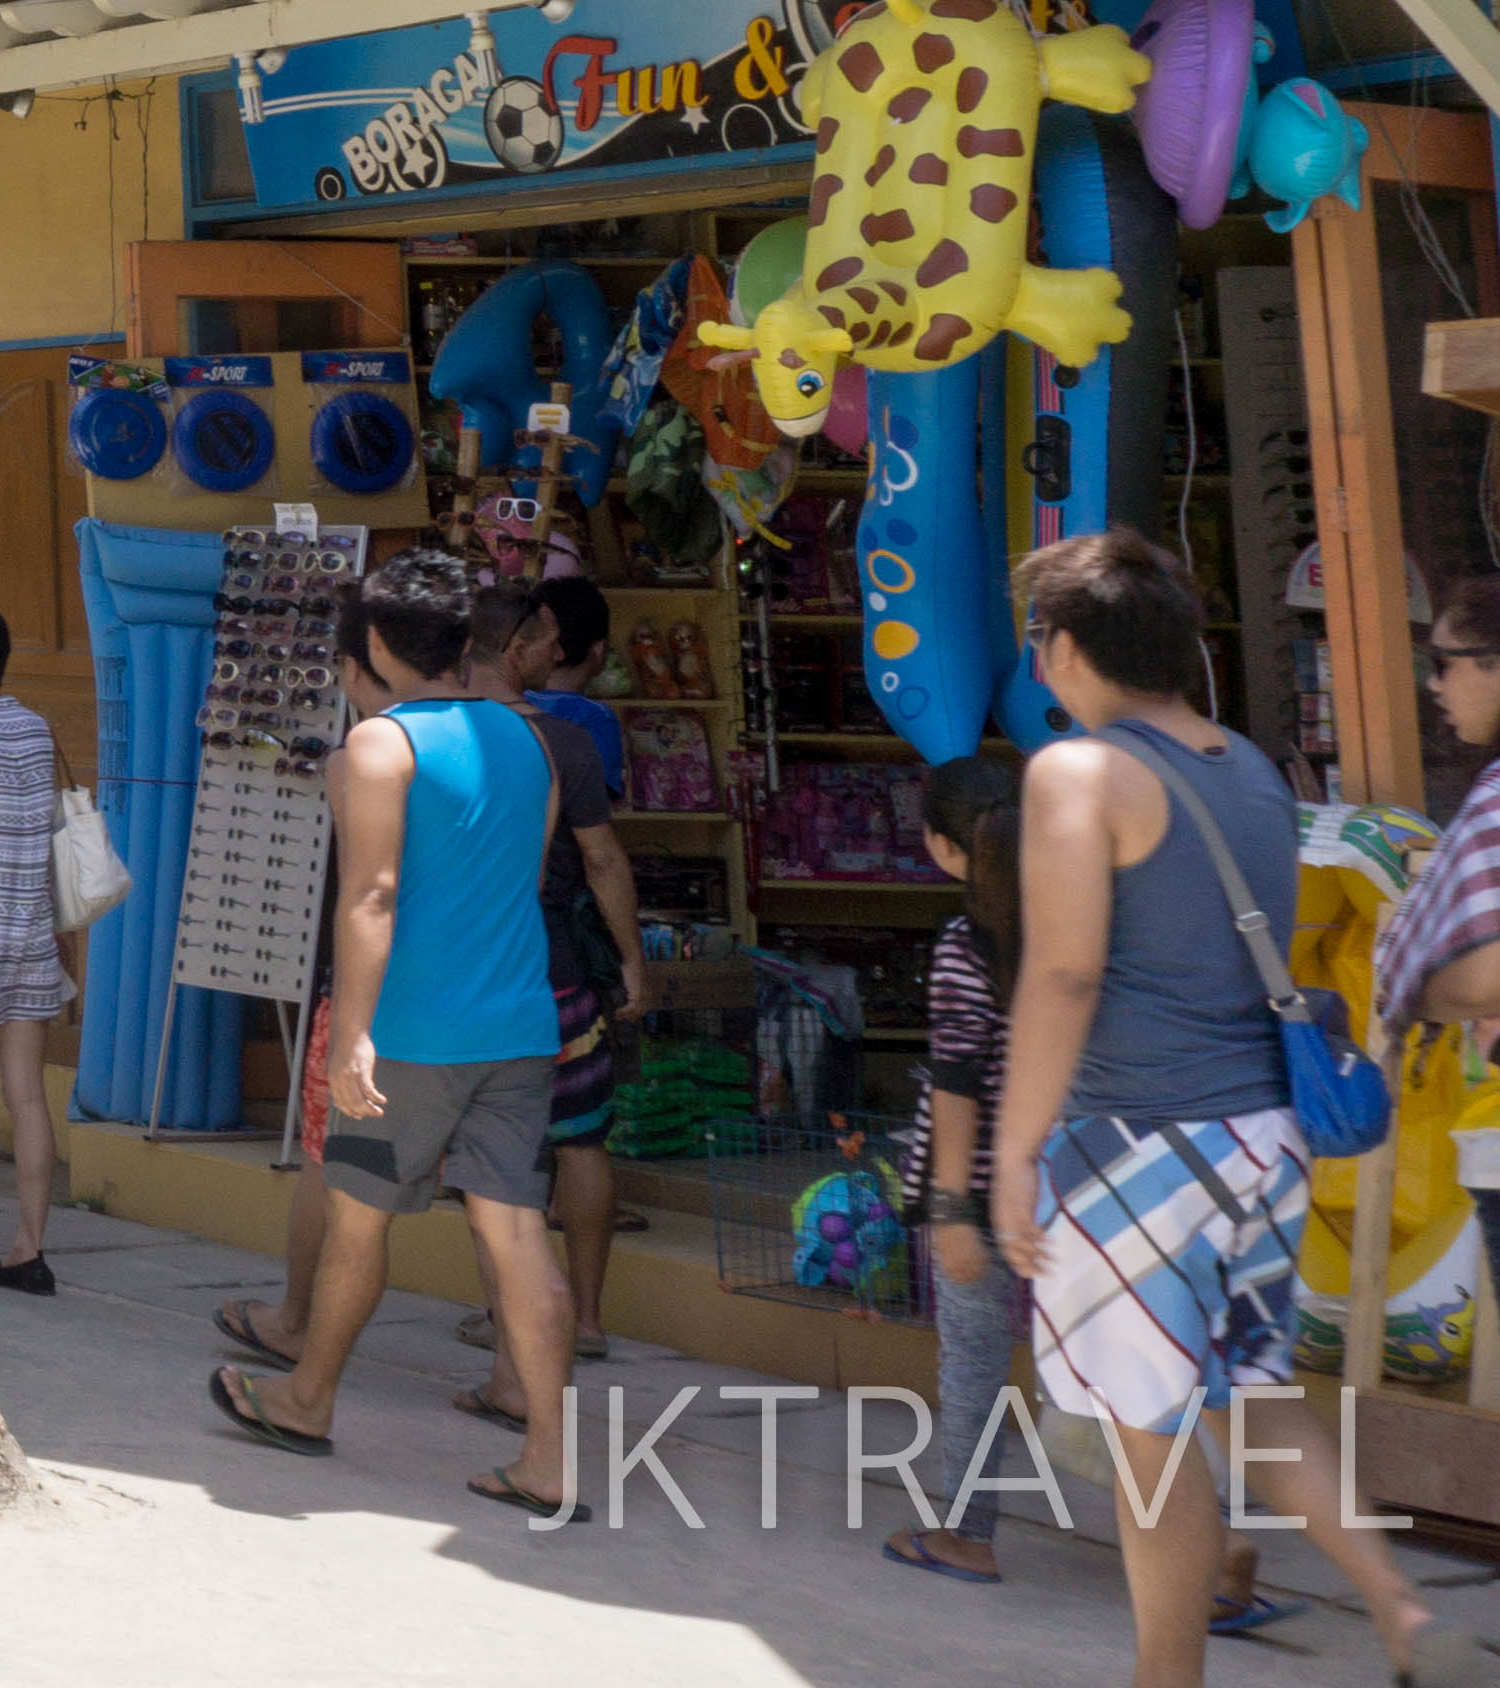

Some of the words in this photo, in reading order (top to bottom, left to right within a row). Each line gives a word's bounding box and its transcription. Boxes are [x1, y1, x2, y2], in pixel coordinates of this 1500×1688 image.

[341, 48, 504, 188] BORACA
[541, 33, 712, 132] Fun
[733, 15, 790, 101] &
